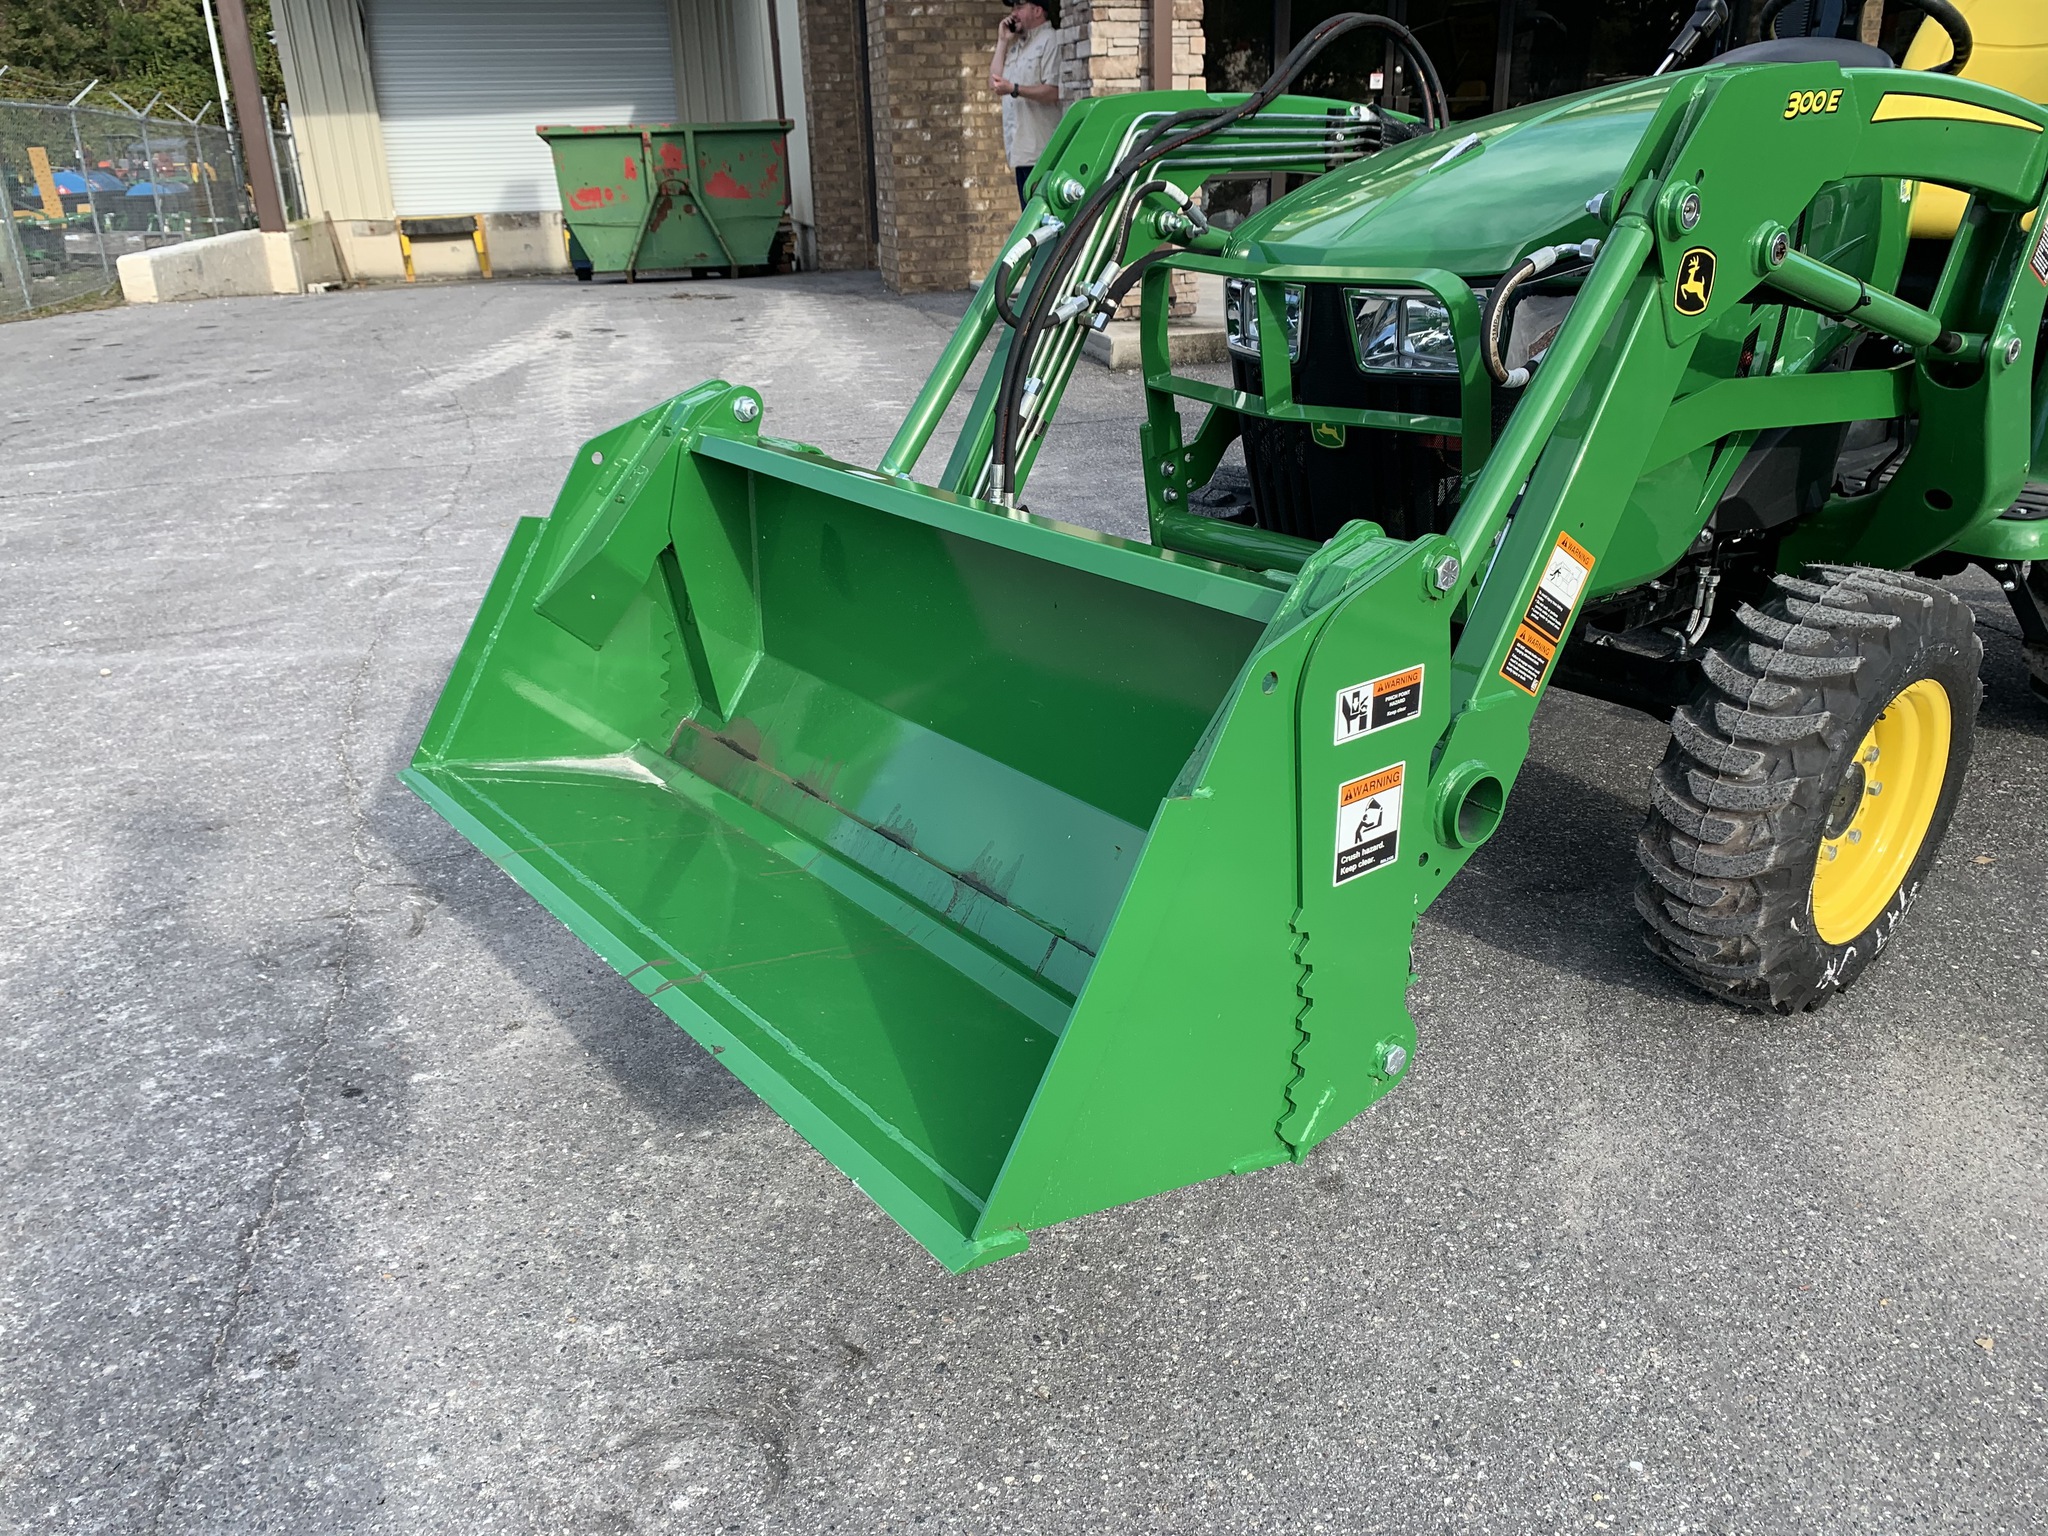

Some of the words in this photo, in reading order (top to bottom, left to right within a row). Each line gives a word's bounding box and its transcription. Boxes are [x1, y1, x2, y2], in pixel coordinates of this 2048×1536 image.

[1783, 88, 1844, 120] 300E
[1567, 542, 1590, 565] WARNING
[1527, 634, 1551, 656] WARNING
[1384, 672, 1418, 689] WARNING
[1353, 771, 1400, 798] WARNING
[1340, 850, 1361, 865] Crush
[1361, 840, 1385, 856] hazard.
[1340, 863, 1357, 876] Keep
[1358, 856, 1376, 868] clear.
